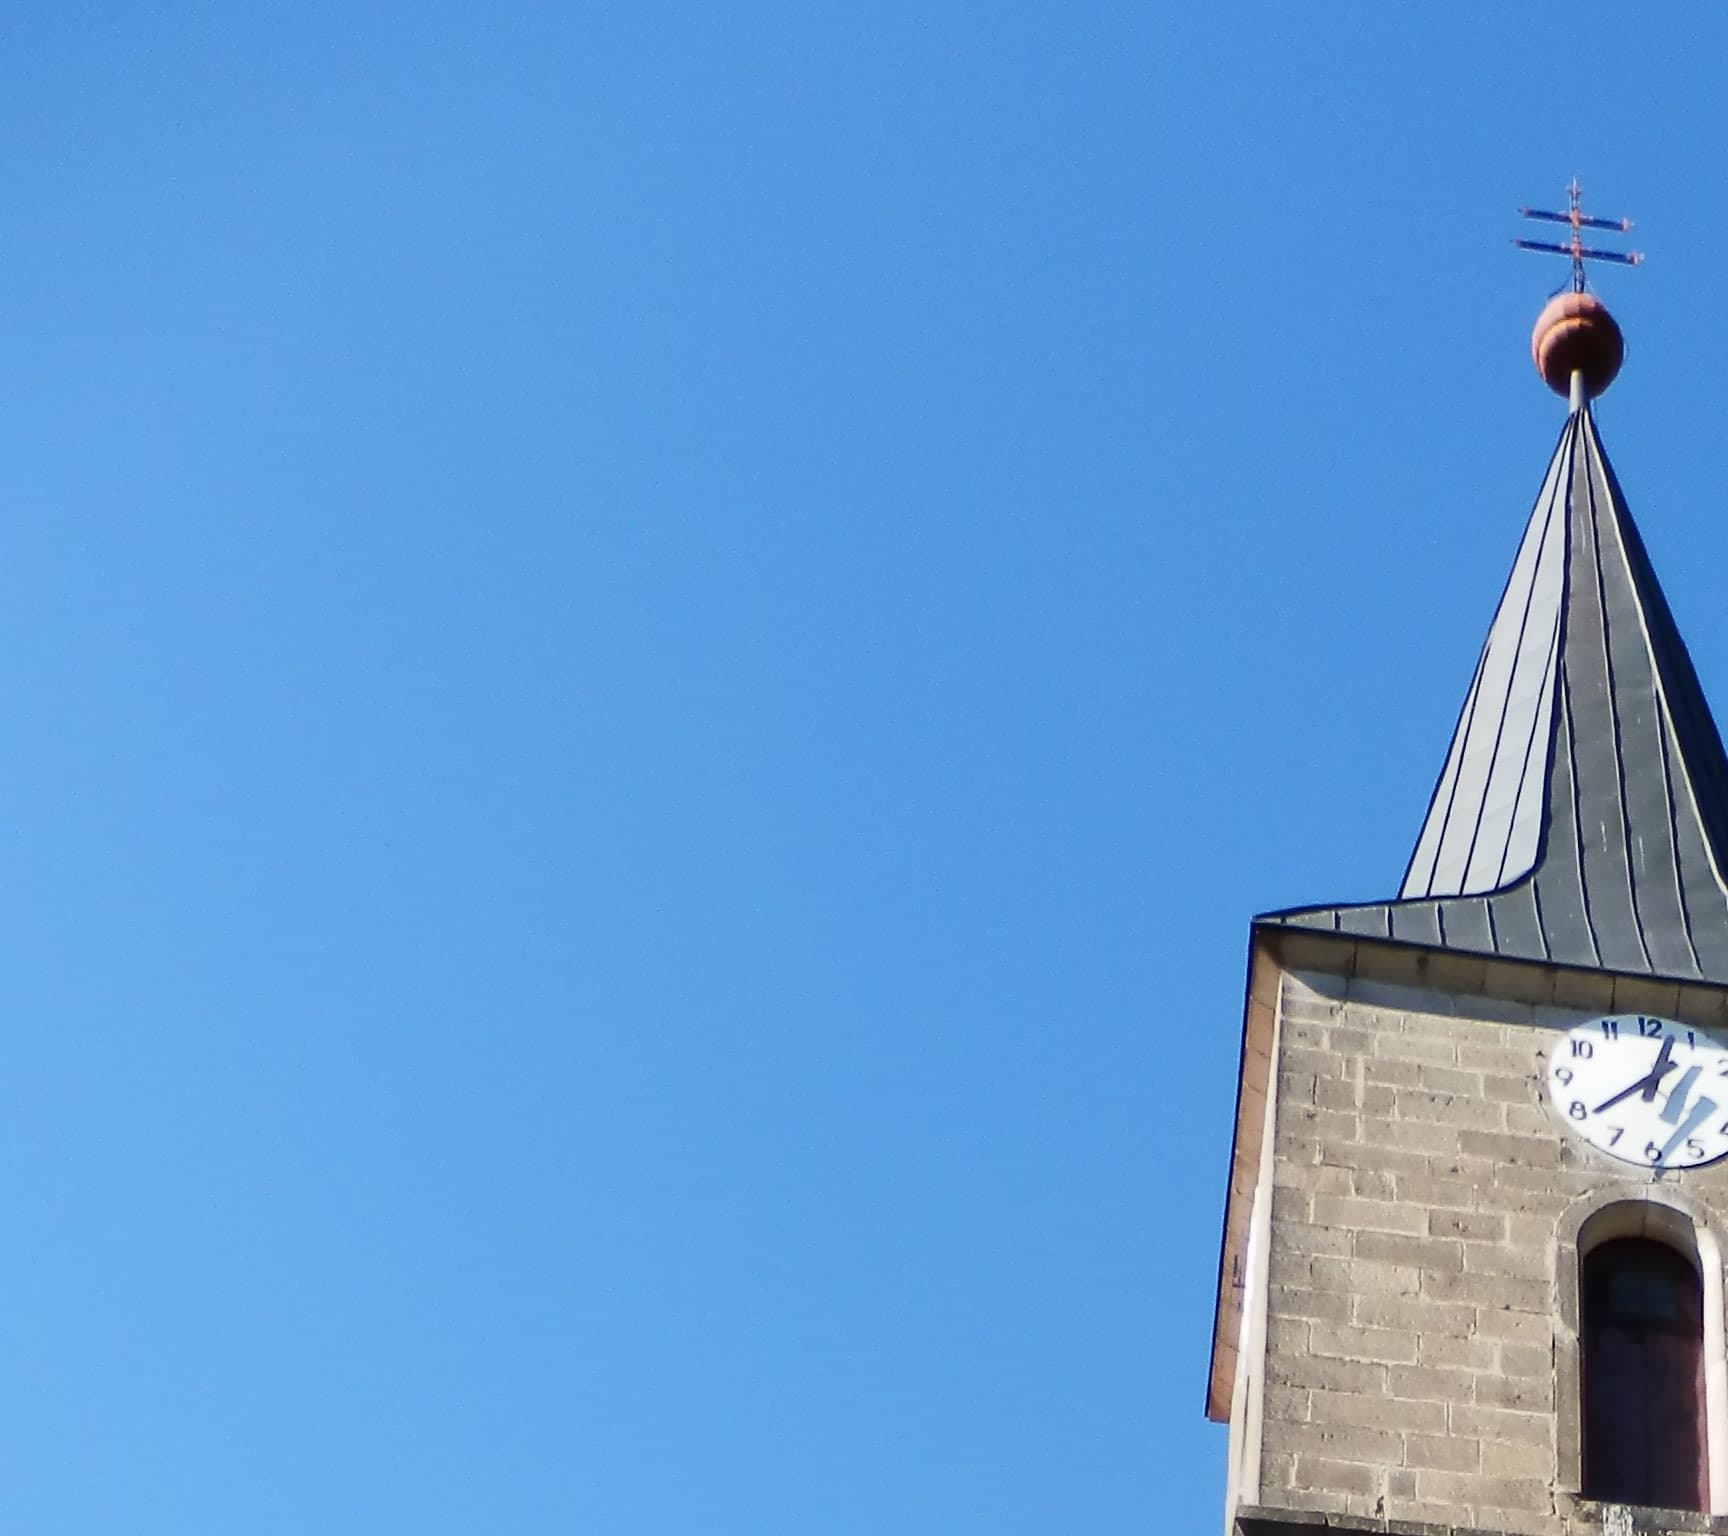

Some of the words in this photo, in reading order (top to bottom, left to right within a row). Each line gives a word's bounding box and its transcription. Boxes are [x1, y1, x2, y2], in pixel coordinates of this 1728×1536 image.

[1601, 1020, 1618, 1040] 11
[1638, 1017, 1662, 1039] 12
[1570, 1039, 1593, 1059] 10
[1688, 1031, 1695, 1050] 1
[1555, 1067, 1573, 1086] 9
[1569, 1100, 1587, 1120] 8
[1607, 1126, 1624, 1146] 7
[1645, 1141, 1662, 1161] 6
[1687, 1138, 1704, 1159] 5
